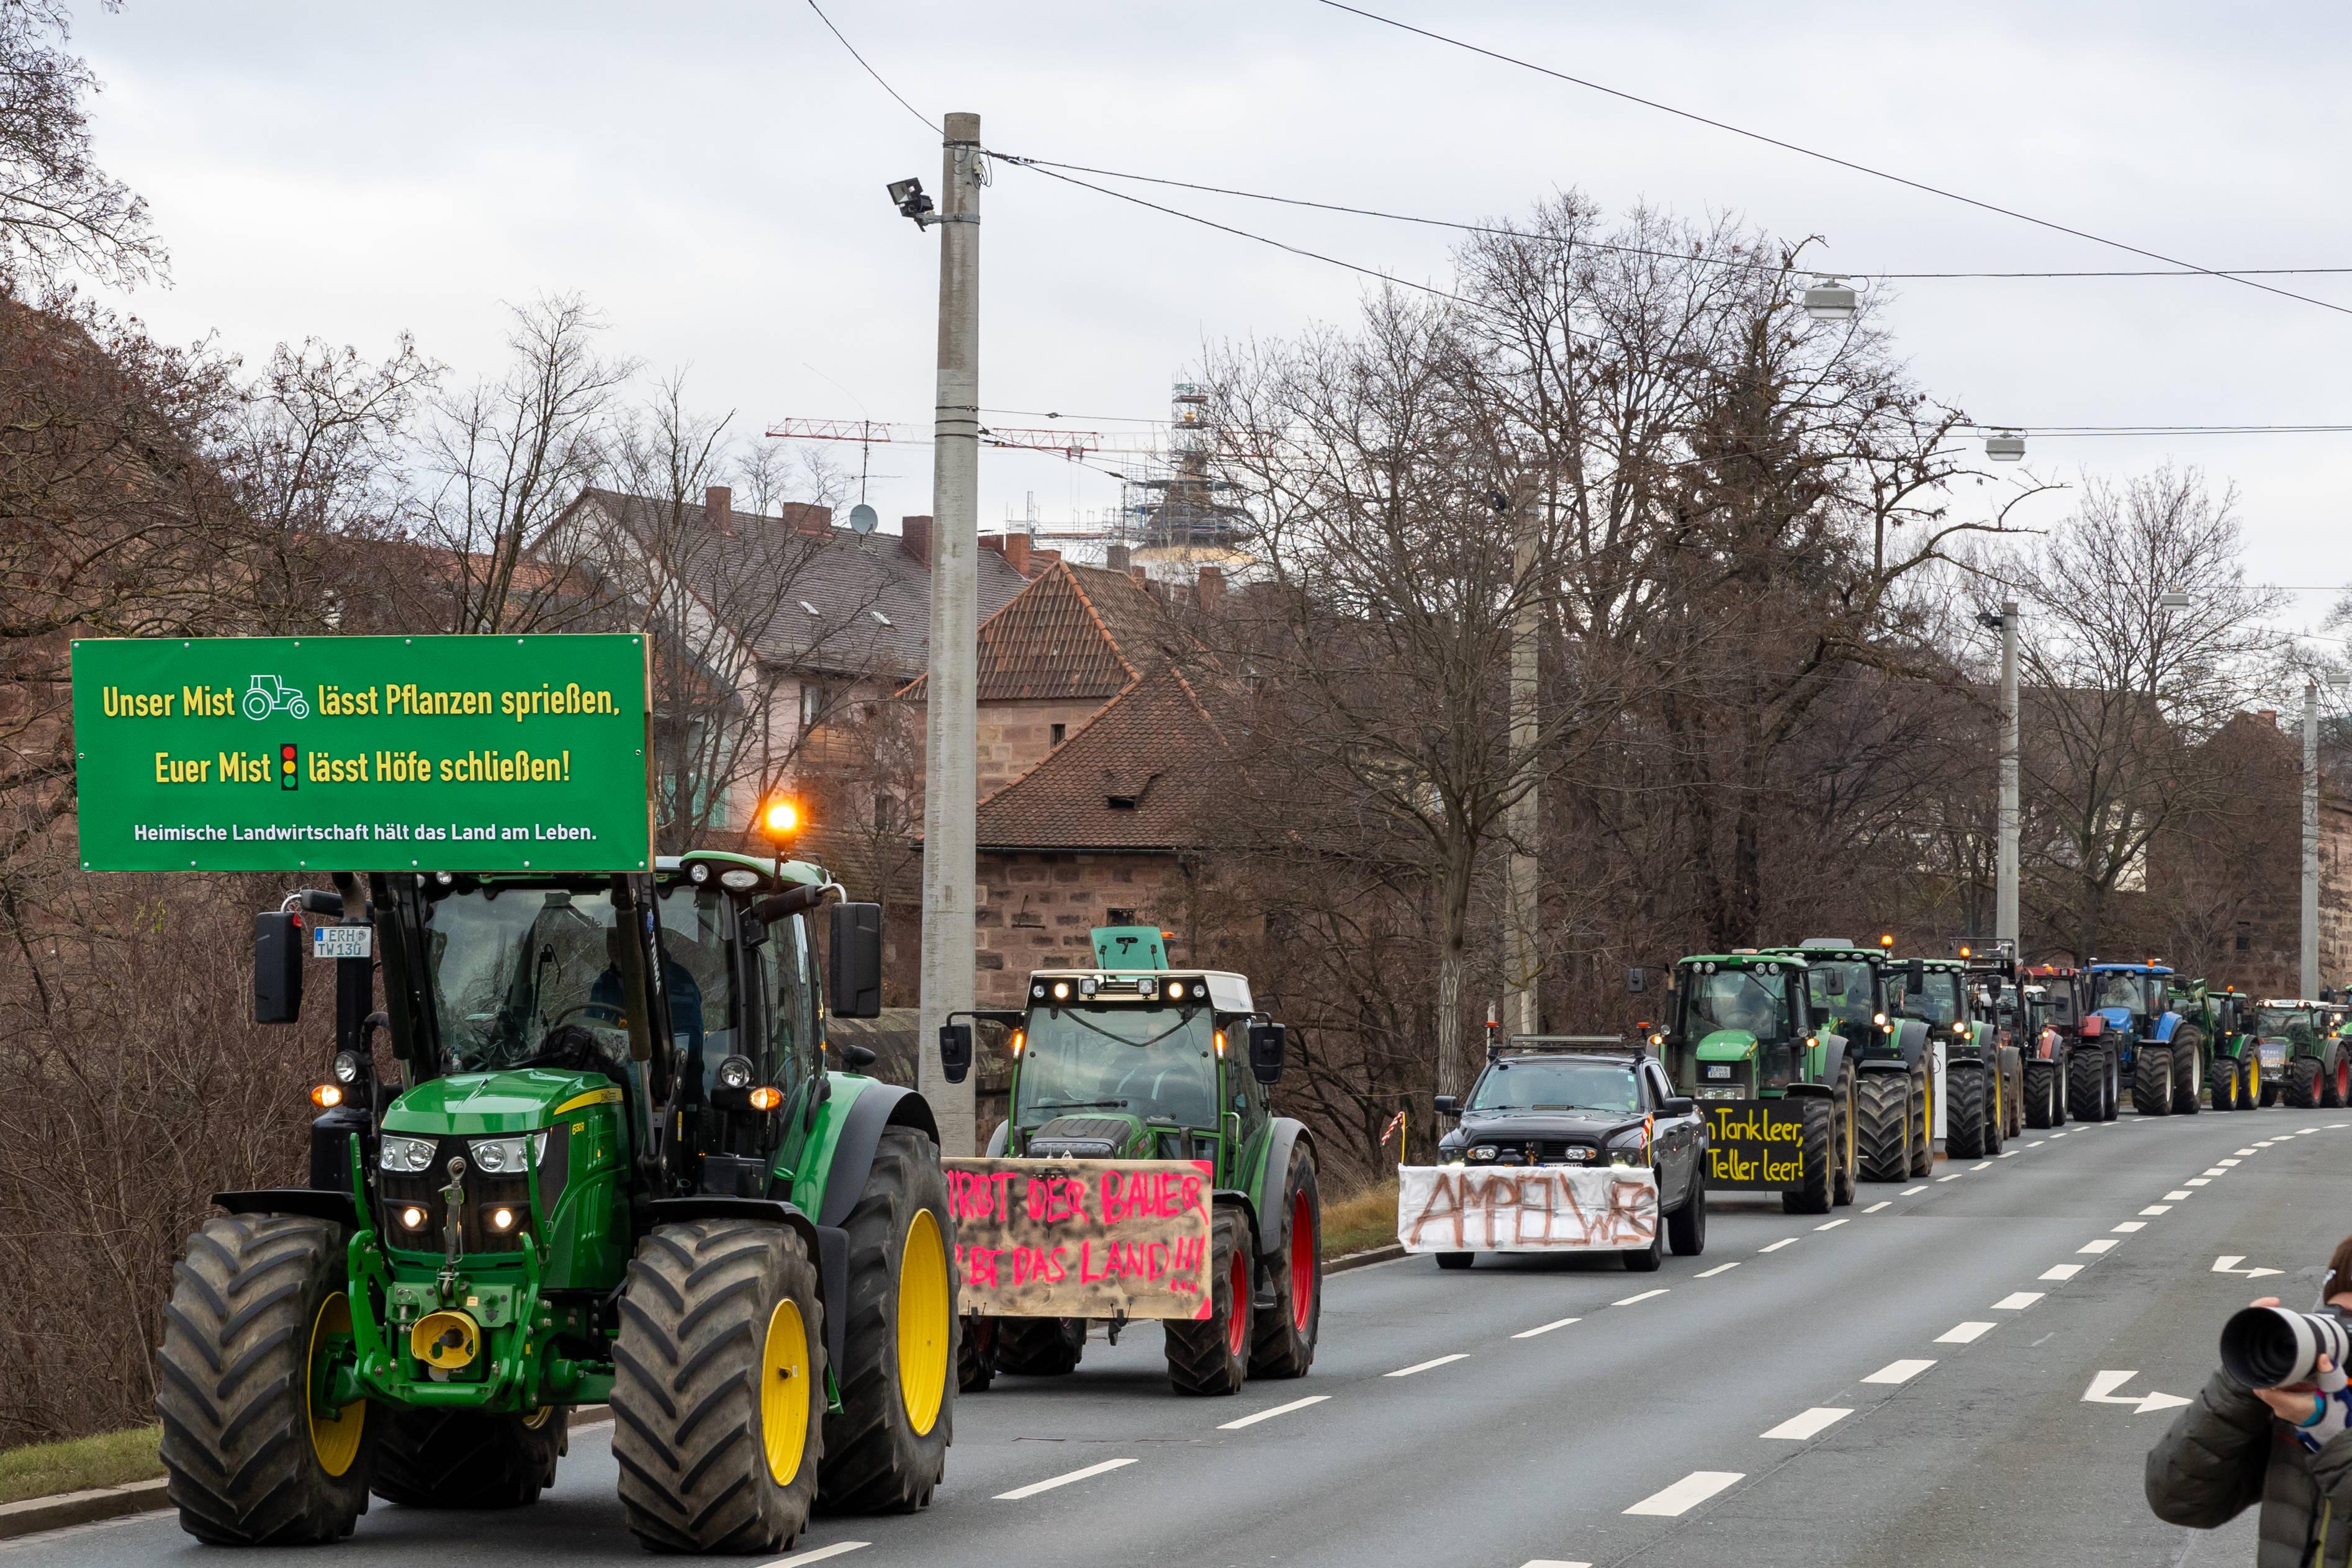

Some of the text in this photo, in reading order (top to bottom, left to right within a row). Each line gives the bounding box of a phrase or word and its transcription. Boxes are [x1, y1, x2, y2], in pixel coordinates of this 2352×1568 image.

[103, 682, 620, 723] Unser Mist lässt Pflanzen sprießen,
[156, 749, 570, 783] Euer Mist lässt Höfe schließen!
[134, 823, 597, 841] Heimische Landwirtschaft hält das Land am Leben.
[318, 943, 361, 955] TW 130
[329, 929, 354, 942] ERH
[651, 931, 660, 995] TRIMA
[1708, 1148, 1804, 1181] Teller leer!
[947, 1169, 1210, 1225] IRBT DER BAUER
[1012, 1245, 1067, 1286] DAS
